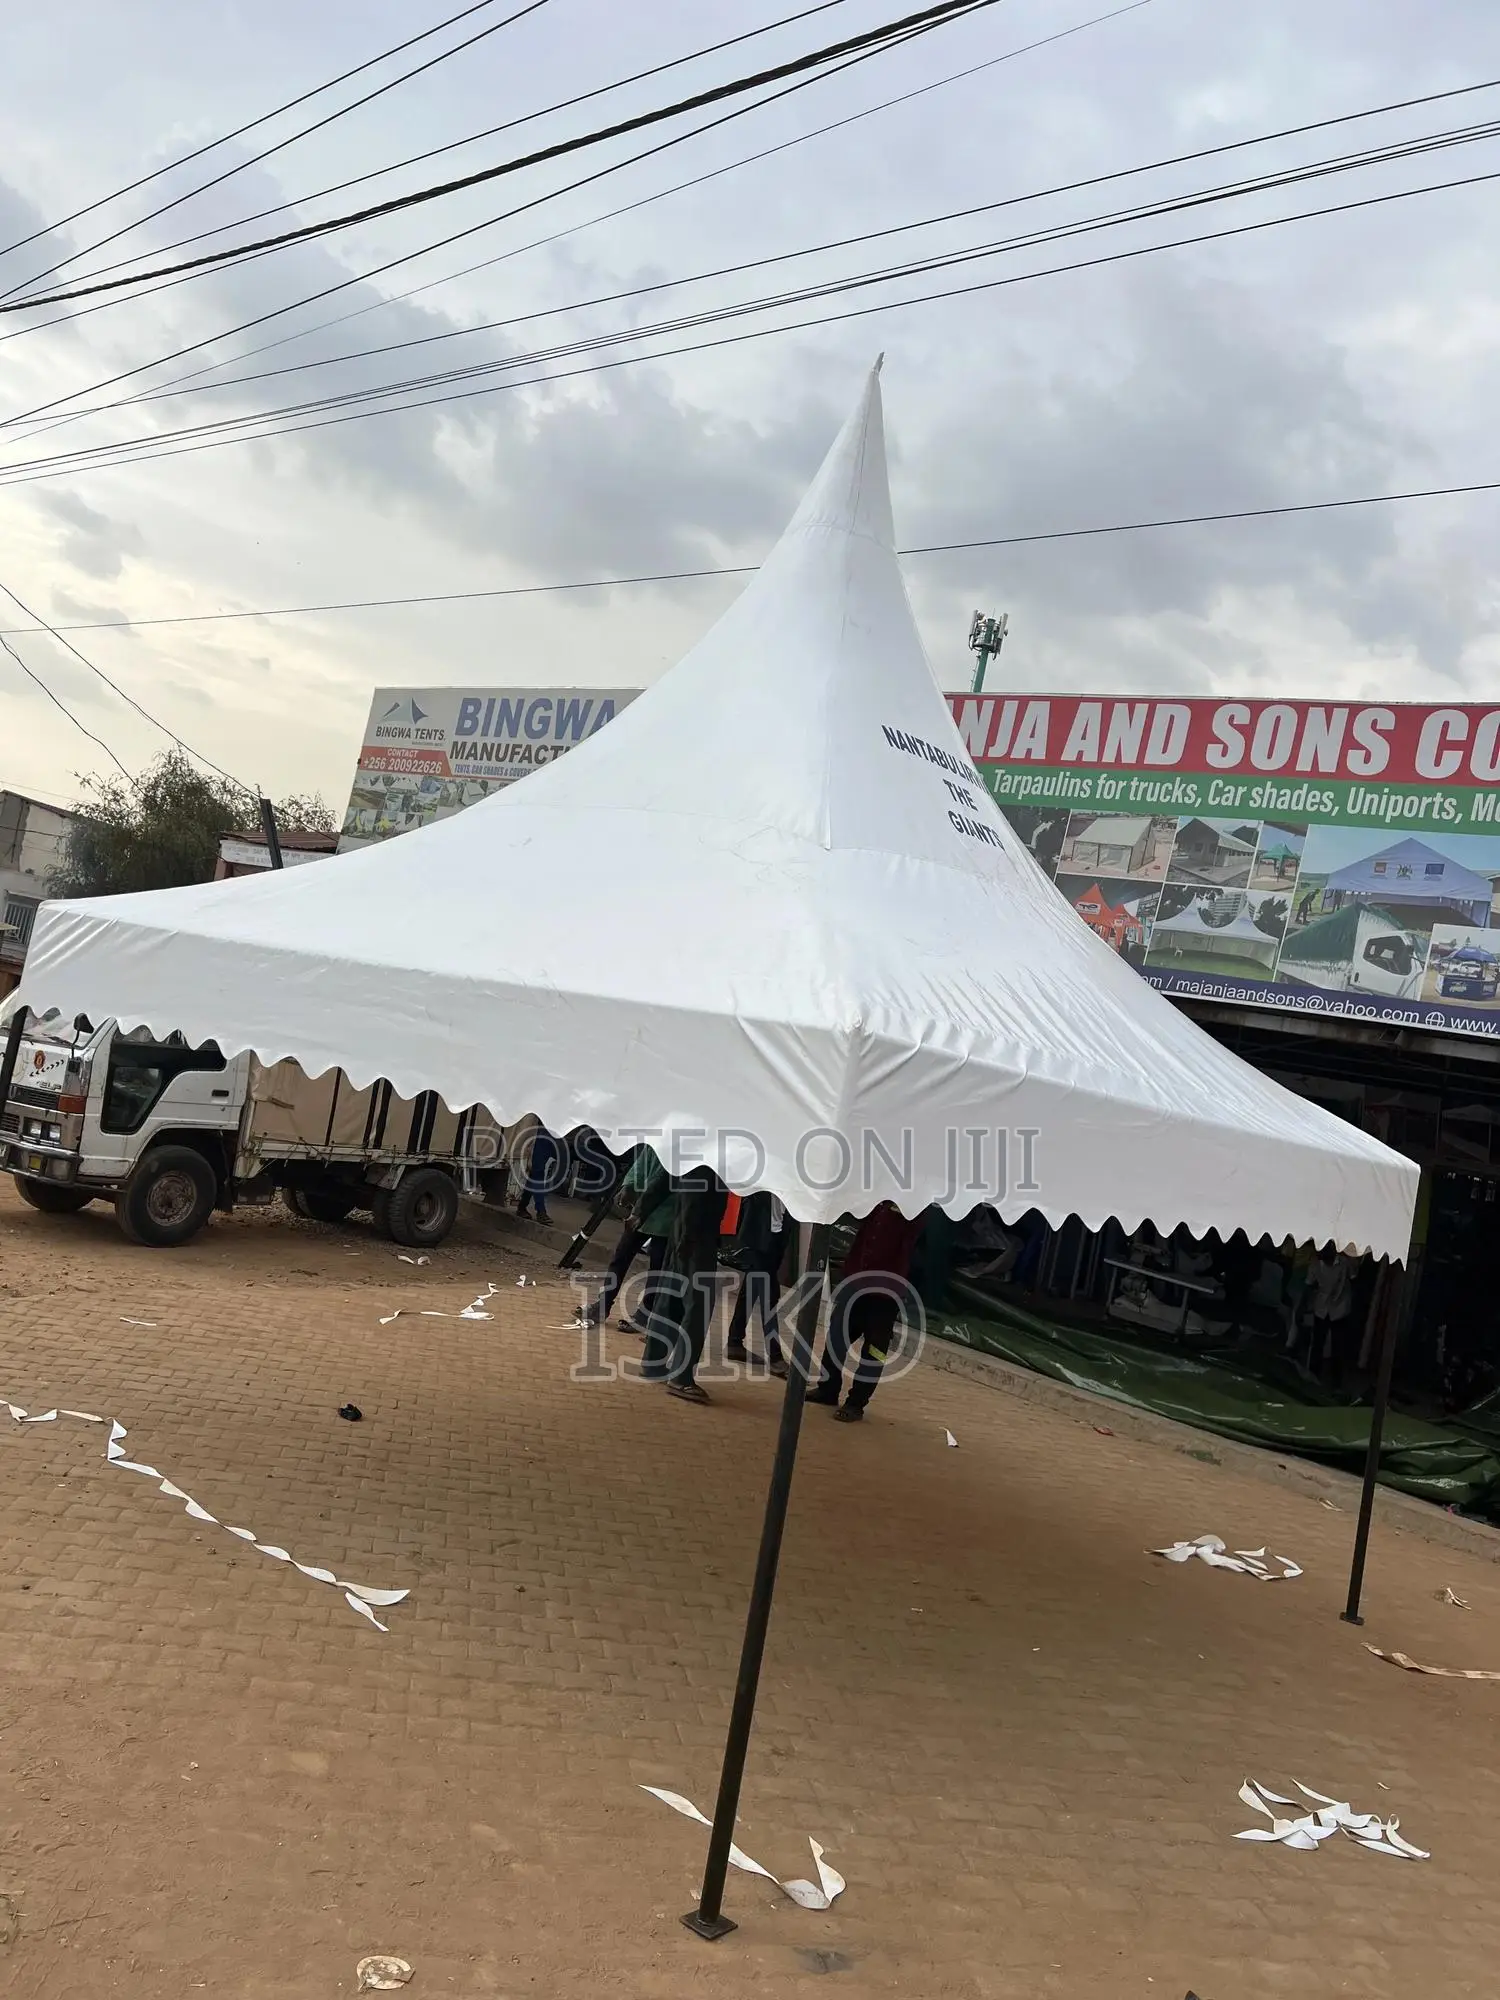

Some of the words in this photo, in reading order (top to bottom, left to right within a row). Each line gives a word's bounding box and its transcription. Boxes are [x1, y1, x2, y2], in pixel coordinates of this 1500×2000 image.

[376, 726, 412, 739] BINGWA
[455, 698, 616, 740] BINGWA
[387, 749, 419, 758] CONTACT
[450, 741, 571, 764] MANUFACT
[947, 699, 1050, 760] NJA
[1060, 702, 1192, 765] AND
[1206, 703, 1396, 776] SONS
[363, 757, 387, 769] +256
[943, 778, 978, 811] THE
[993, 769, 1093, 800] Tarpaulins
[1096, 773, 1127, 801] for
[1129, 776, 1202, 807] trucks,
[1208, 779, 1246, 806] Car
[1249, 781, 1340, 816] shades,
[1347, 786, 1463, 824] Uniports,
[1470, 793, 1500, 822] M
[948, 810, 1006, 851] GIANTS
